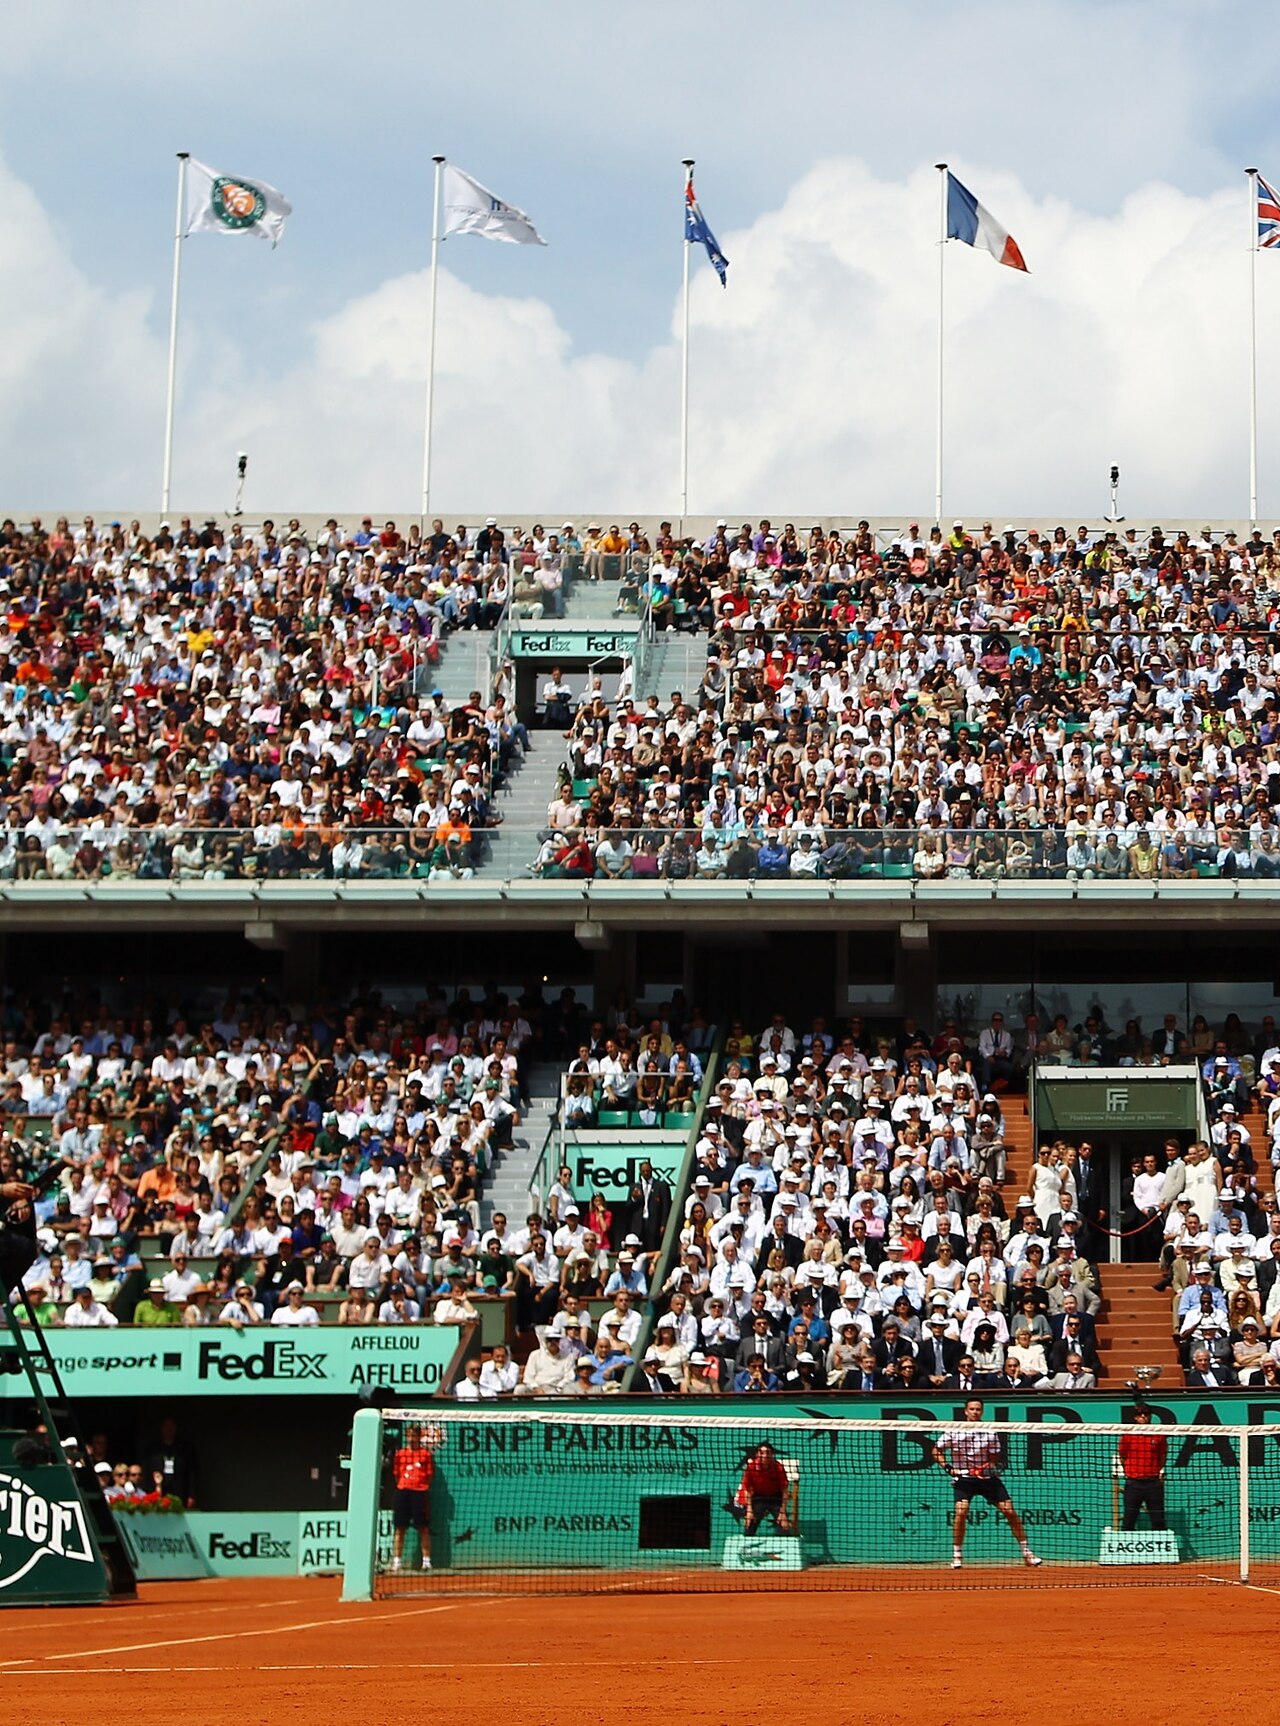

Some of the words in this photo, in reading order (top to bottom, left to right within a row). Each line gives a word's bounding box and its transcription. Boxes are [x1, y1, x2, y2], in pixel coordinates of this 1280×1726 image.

[521, 636, 570, 651] FedEx
[351, 1336, 420, 1350] AFFLELOU
[91, 1353, 158, 1371] sport
[198, 1341, 328, 1379] FedEx
[459, 1425, 534, 1453] BNP
[545, 1424, 699, 1451] PARIBAS
[495, 1516, 537, 1532] BNP
[543, 1514, 634, 1532] PARIBAS
[209, 1532, 291, 1558] FedEx
[1108, 1541, 1172, 1553] LACOSTE
